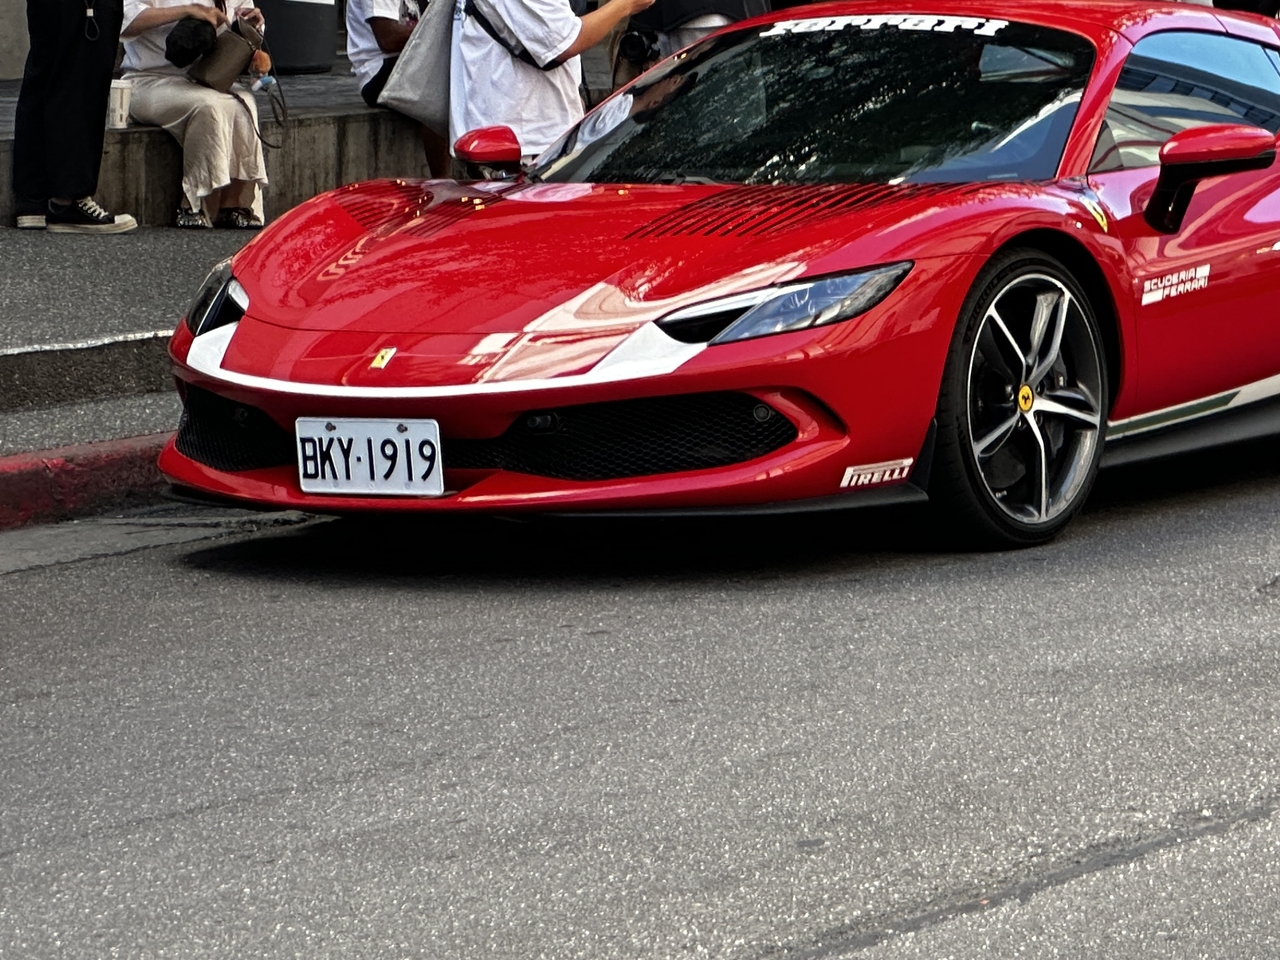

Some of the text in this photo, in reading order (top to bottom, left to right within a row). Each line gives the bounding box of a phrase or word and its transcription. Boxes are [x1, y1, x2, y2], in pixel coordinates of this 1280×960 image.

[1143, 267, 1197, 294] SCUDERIA
[1162, 275, 1209, 300] FERRARI
[839, 456, 914, 488] PIRELLI
